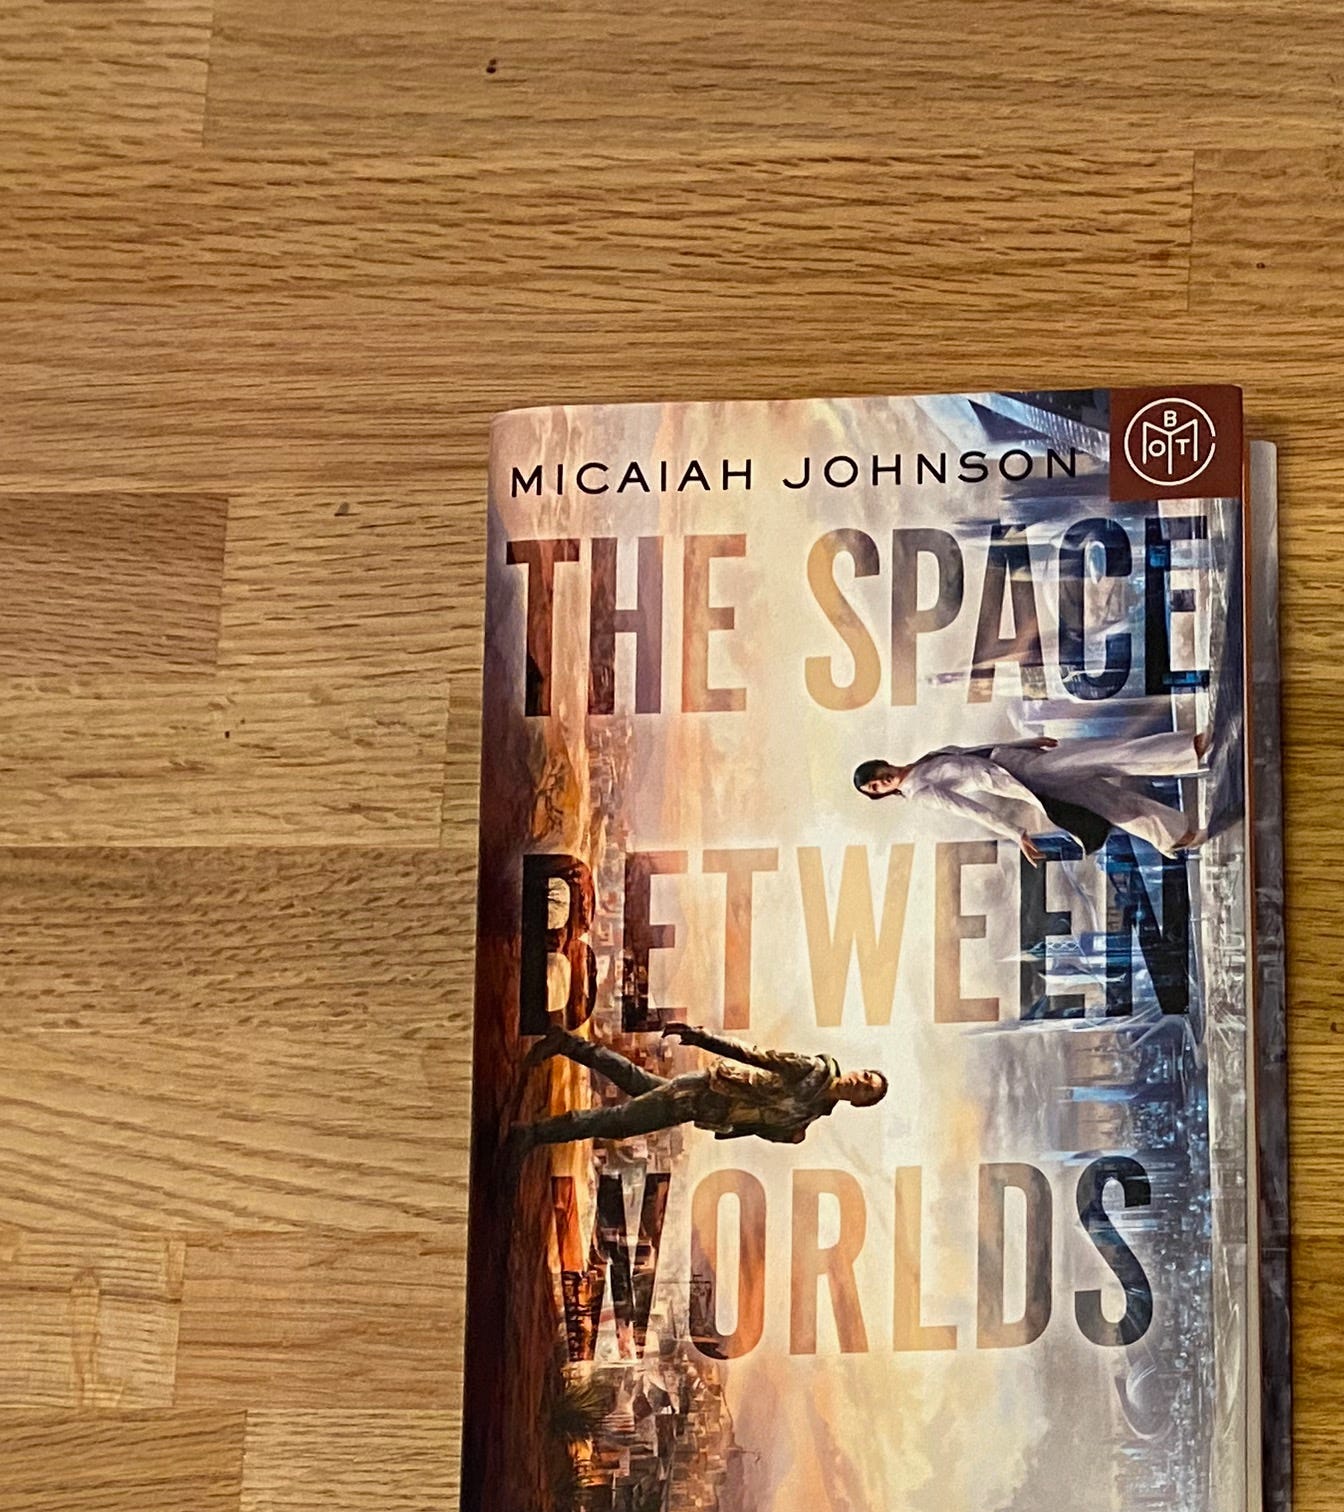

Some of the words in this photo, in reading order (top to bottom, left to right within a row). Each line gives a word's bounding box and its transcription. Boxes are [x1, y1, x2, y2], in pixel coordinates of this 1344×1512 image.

[511, 460, 753, 497] MICAIAH
[782, 447, 1078, 490] JOHNSON
[506, 534, 747, 717] THE
[804, 515, 1208, 712] SPACE
[518, 834, 1192, 1037] BETWEEN
[551, 1155, 1153, 1362] WORLDS
